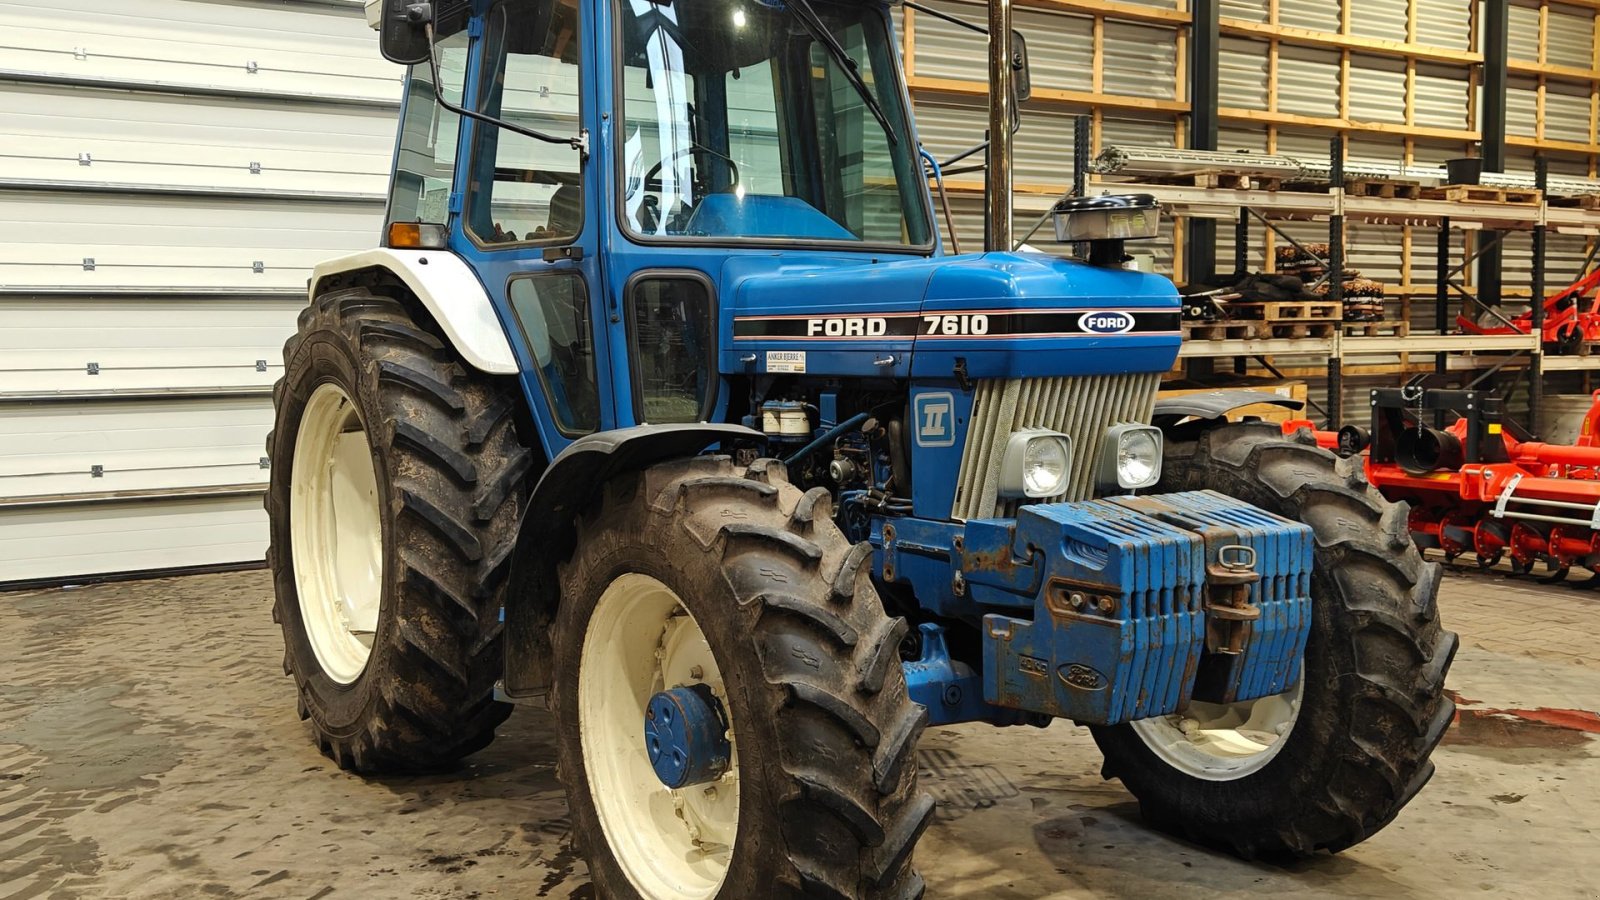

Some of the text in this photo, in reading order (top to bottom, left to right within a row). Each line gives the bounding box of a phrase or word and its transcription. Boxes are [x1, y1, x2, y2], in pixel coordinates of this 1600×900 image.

[807, 315, 988, 336] FORD 7610
[1088, 317, 1126, 328] FORD
[767, 353, 783, 361] ANKER
[921, 403, 949, 435] II
